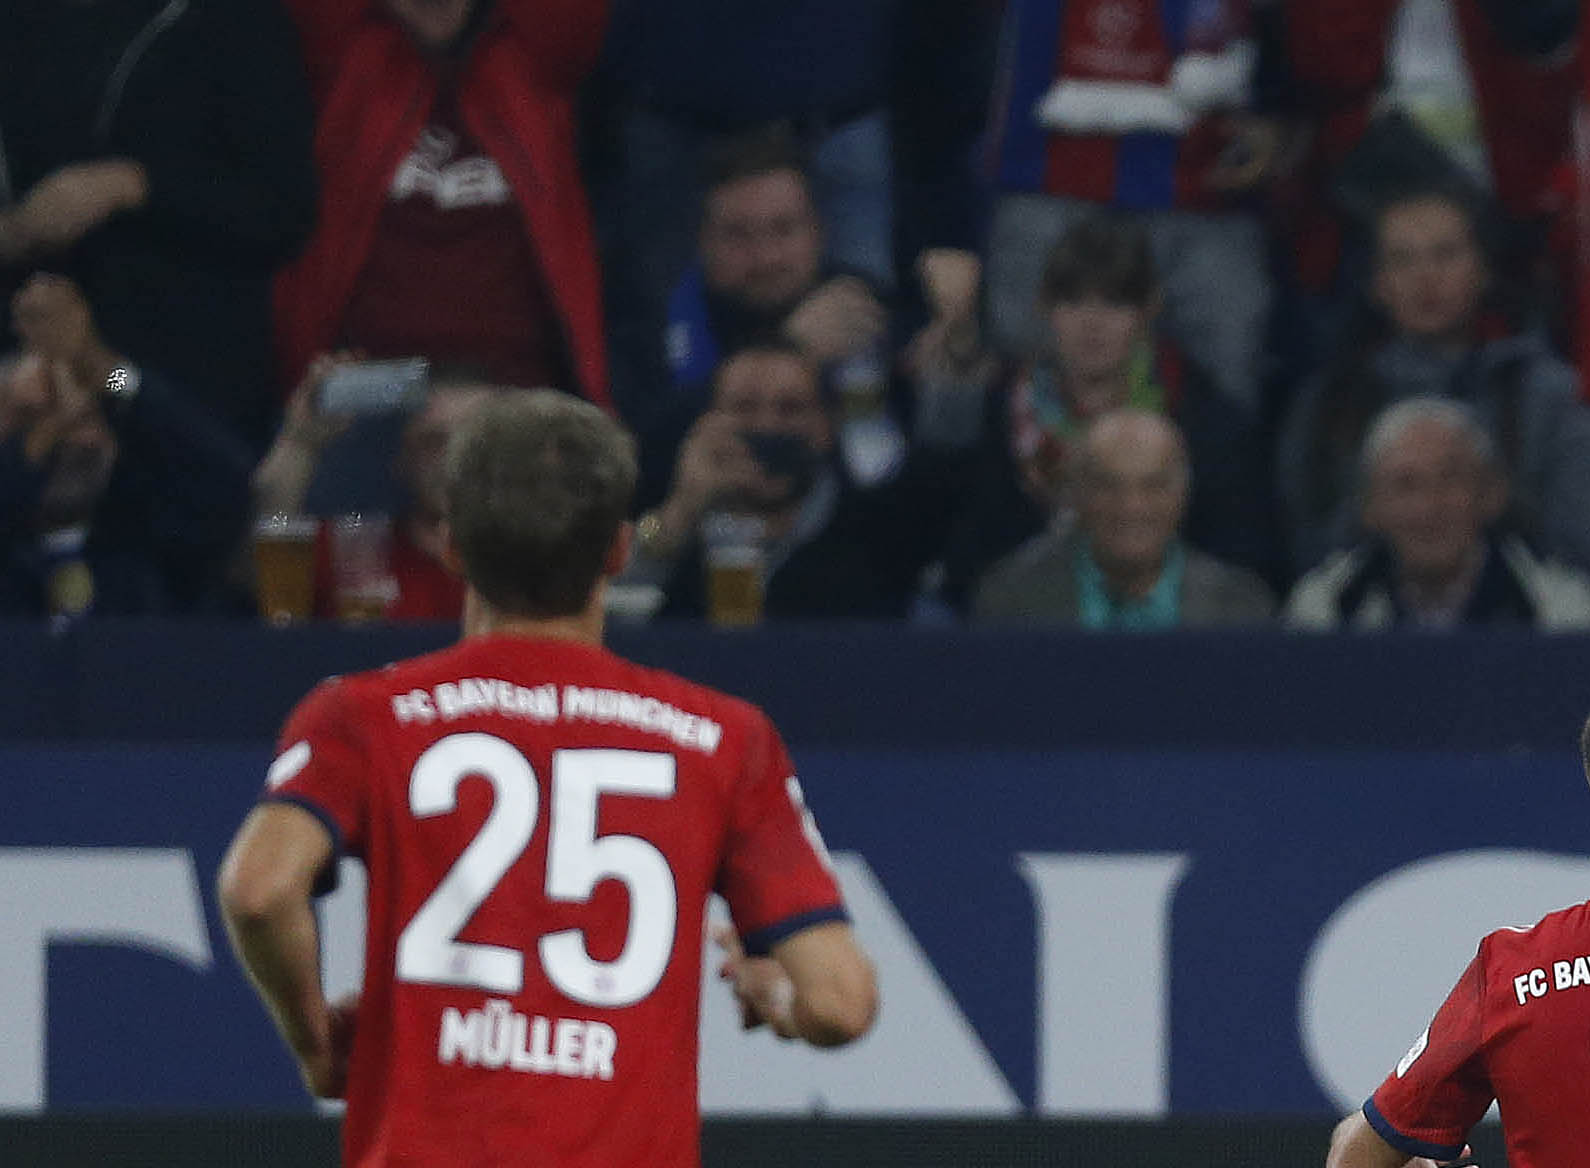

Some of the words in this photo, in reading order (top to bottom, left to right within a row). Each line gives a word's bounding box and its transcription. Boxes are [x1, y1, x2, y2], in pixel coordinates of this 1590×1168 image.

[395, 731, 678, 1008] 25
[1514, 968, 1548, 1005] FC
[438, 998, 618, 1080] MÜLLER
